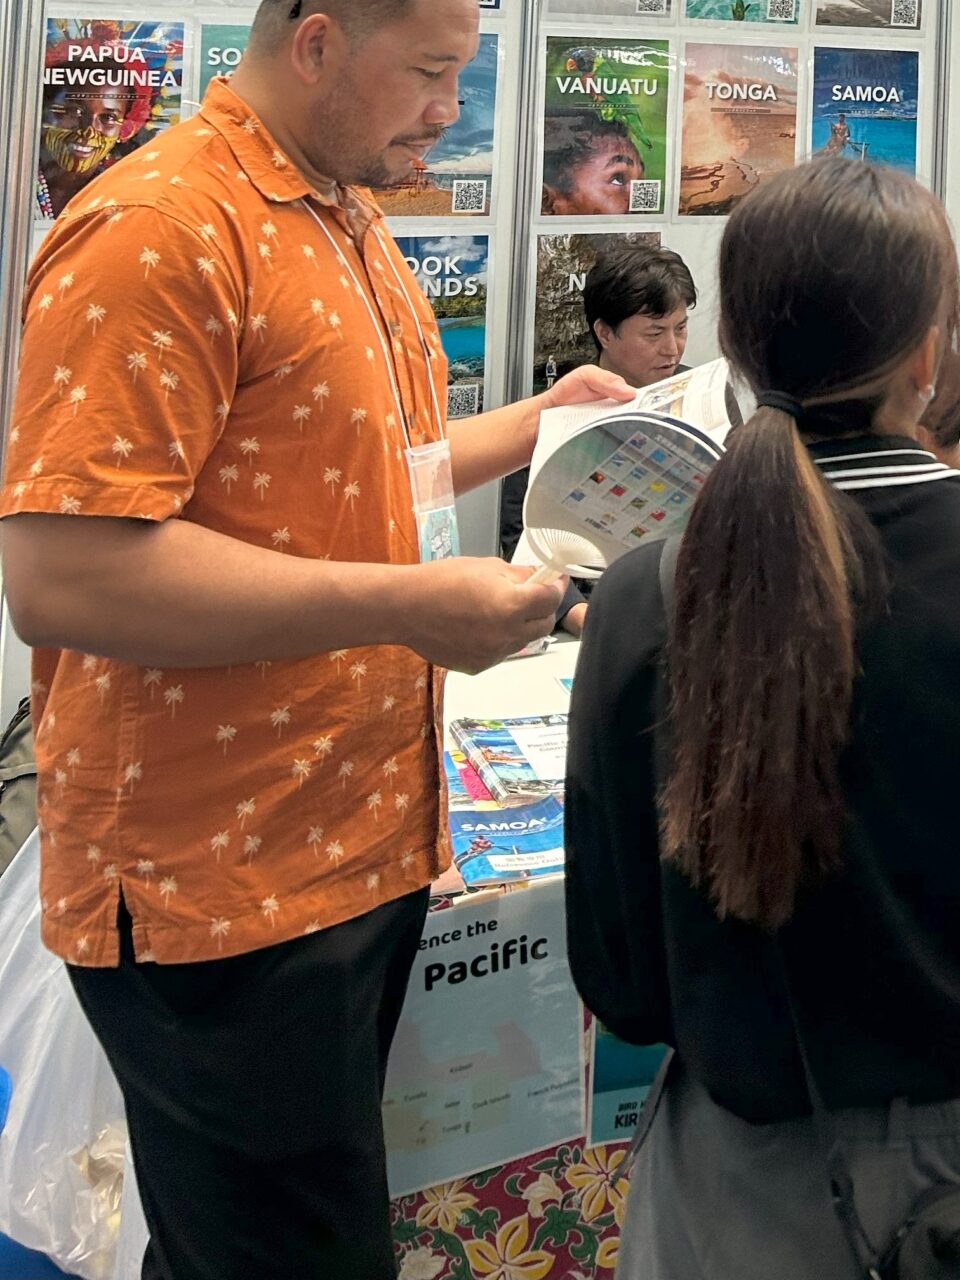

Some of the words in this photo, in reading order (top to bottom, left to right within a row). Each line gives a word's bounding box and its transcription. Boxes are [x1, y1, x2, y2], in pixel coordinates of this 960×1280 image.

[68, 46, 146, 64] PAPUA
[44, 68, 177, 88] NEWGUINEA
[556, 77, 657, 96] VANUATU
[705, 82, 777, 101] TONGA
[832, 85, 900, 103] SAMOA
[461, 817, 547, 833] SAMOA
[467, 920, 498, 938] the
[425, 935, 548, 992] Pacific
